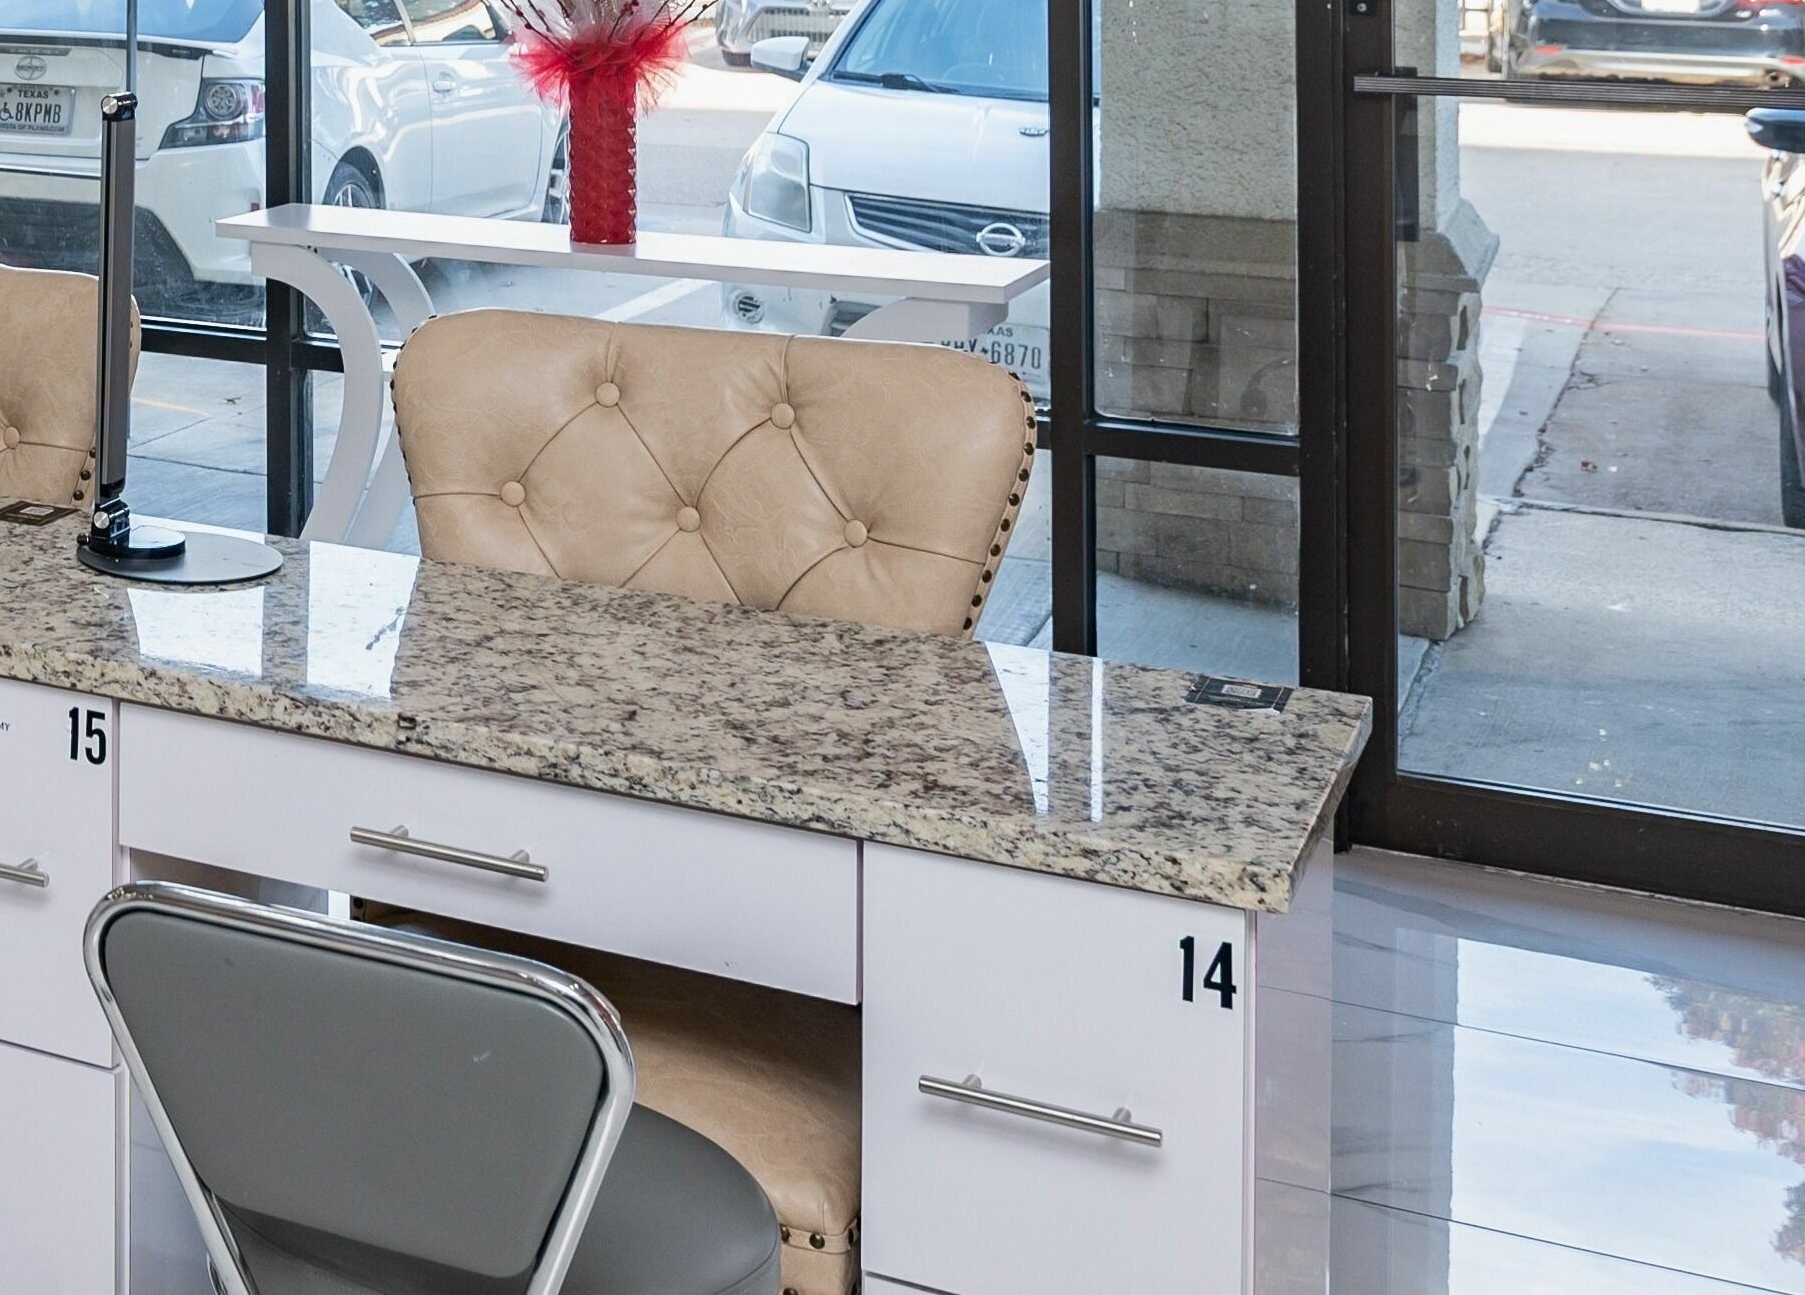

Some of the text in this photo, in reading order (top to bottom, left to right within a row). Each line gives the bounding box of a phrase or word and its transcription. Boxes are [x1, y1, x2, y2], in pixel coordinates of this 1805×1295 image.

[17, 89, 49, 99] TEXAS
[68, 706, 107, 765] 15
[1179, 935, 1238, 1010] 14
